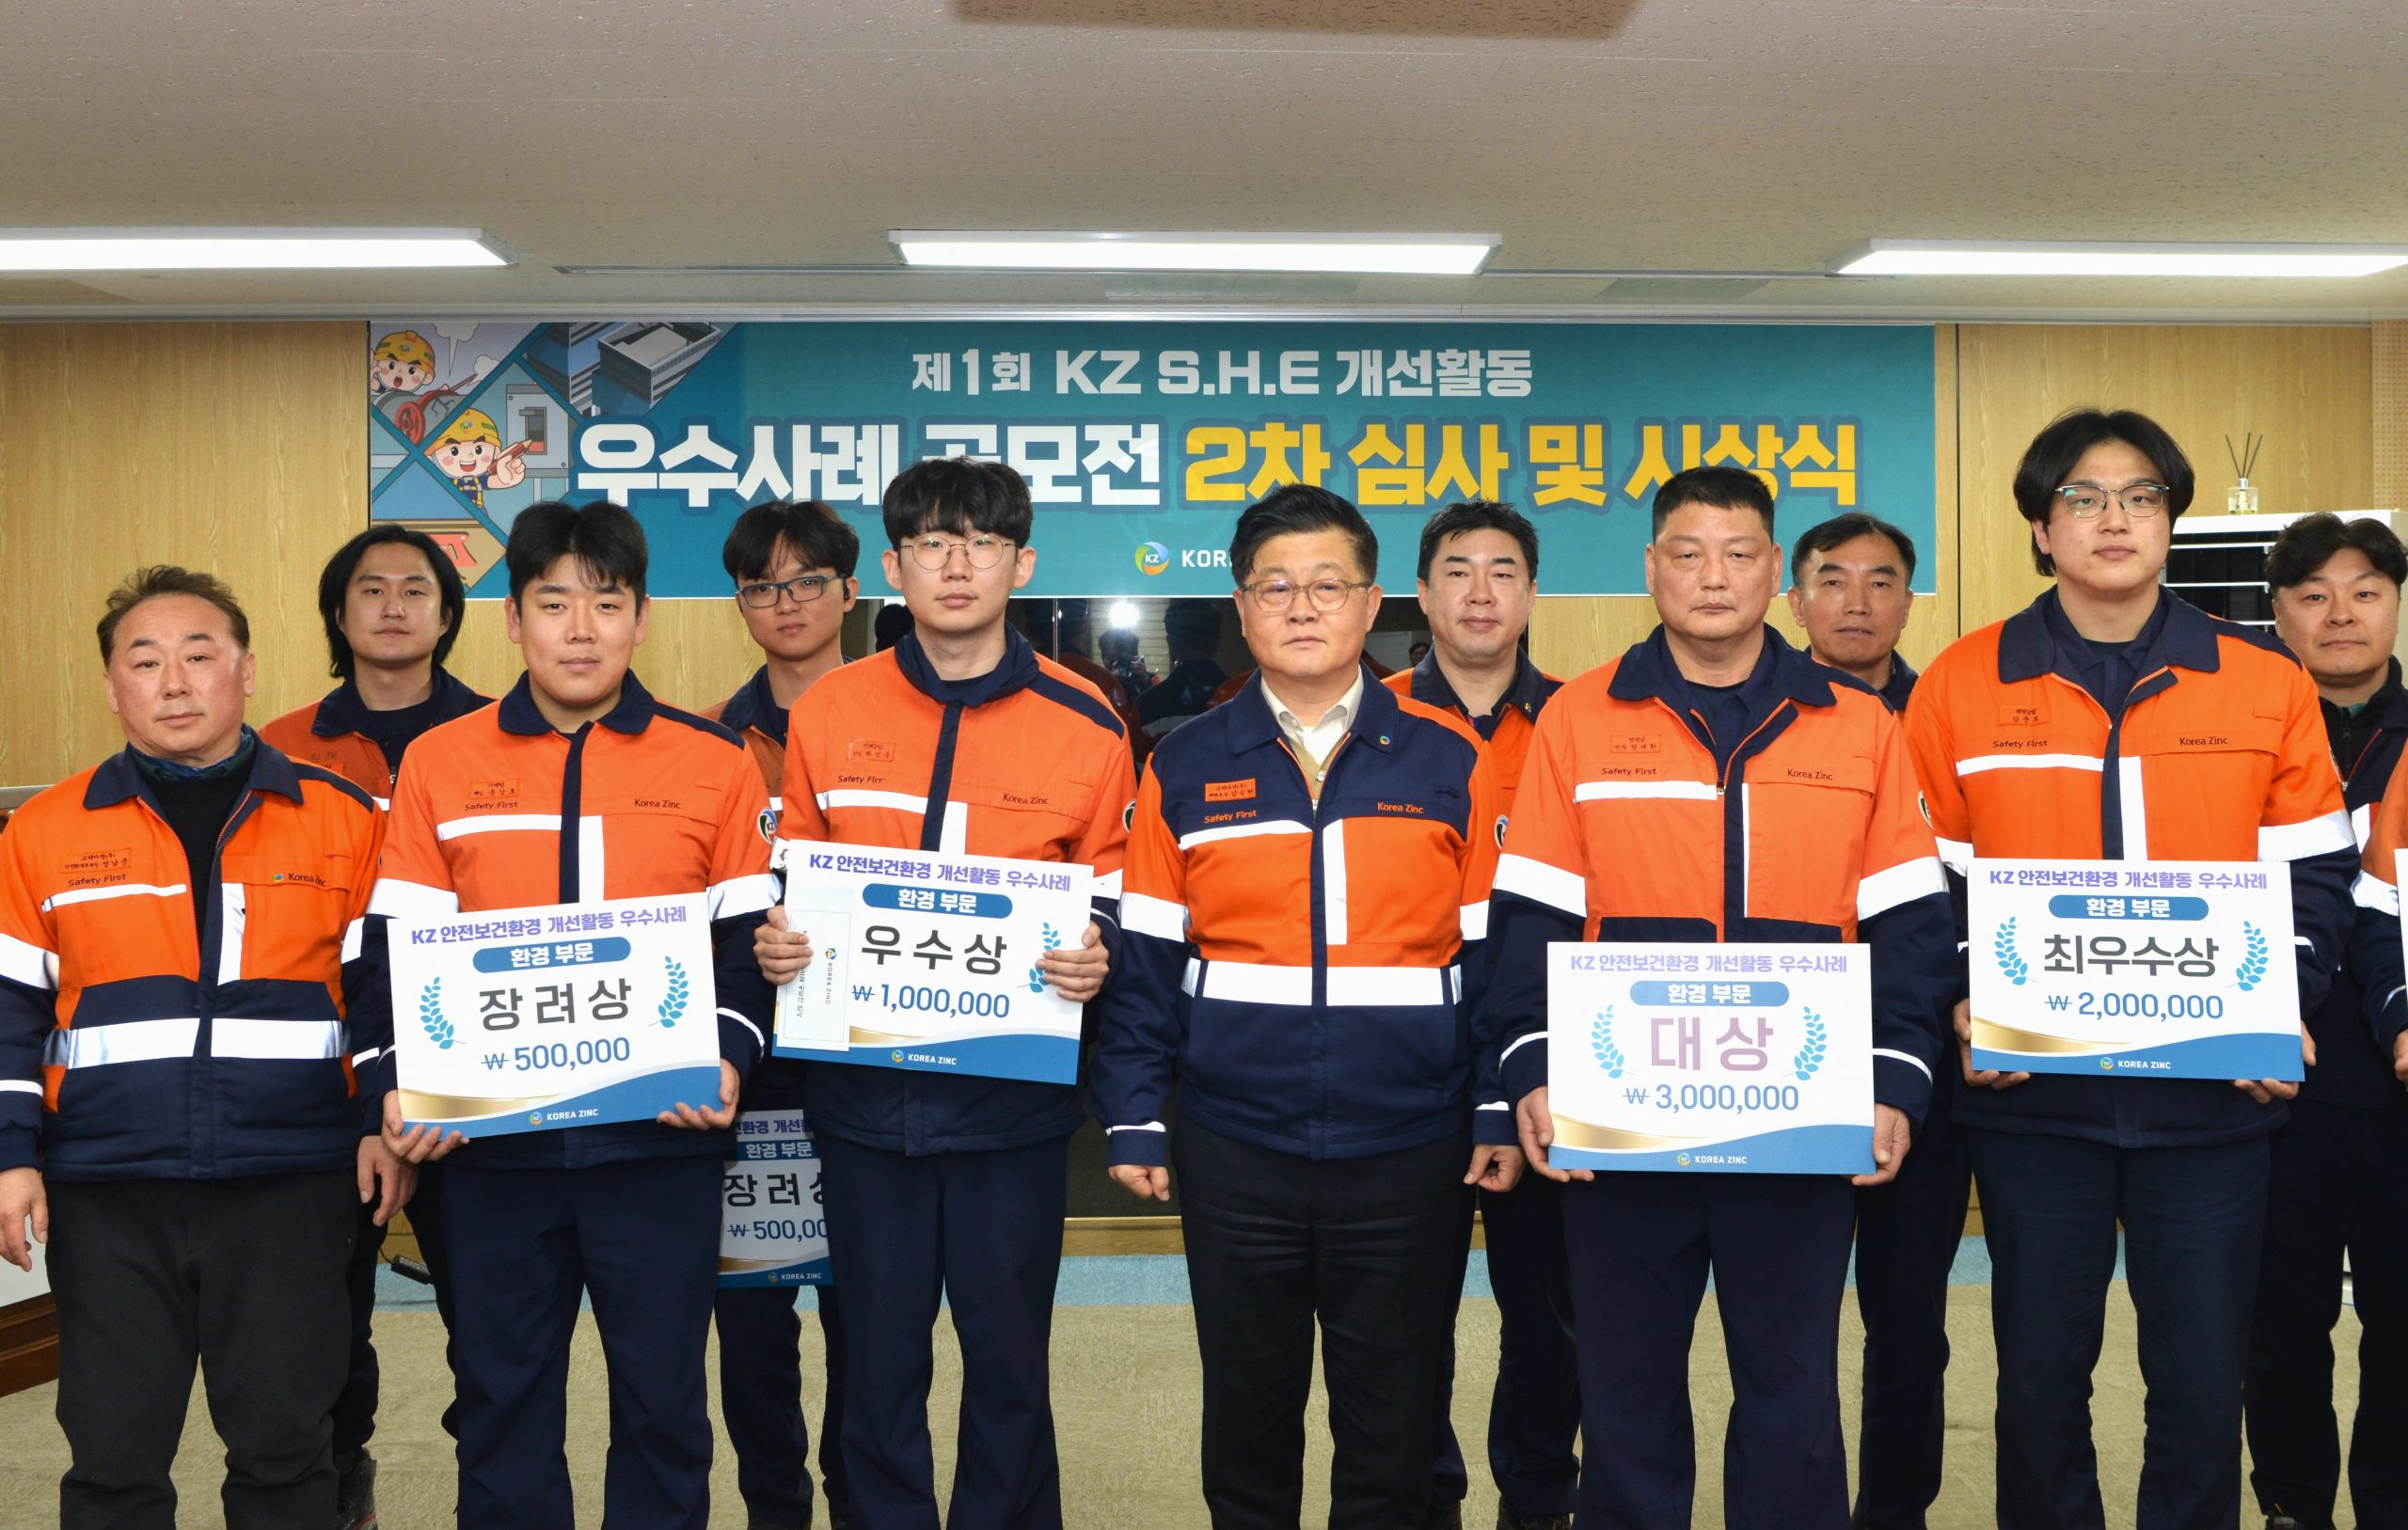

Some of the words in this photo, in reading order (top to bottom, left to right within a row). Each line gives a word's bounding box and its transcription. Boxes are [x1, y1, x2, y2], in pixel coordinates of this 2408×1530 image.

[912, 349, 1031, 396] 제1회
[1055, 351, 1141, 395] KZ
[1158, 350, 1322, 395] S.H.E
[1336, 349, 1533, 397] 개선활동
[578, 424, 899, 506] 우수사례
[1185, 422, 1330, 503] 2차
[1347, 422, 1510, 505] 심사
[1529, 424, 1608, 506] 및
[1145, 554, 1160, 563] KZ
[1181, 549, 1232, 568] KOR
[1992, 740, 2023, 749] Safety
[2026, 739, 2048, 748] First
[2179, 735, 2207, 746] Korea
[2209, 735, 2228, 745] Zinc
[1602, 767, 1632, 776] Safety
[1787, 768, 1812, 780] Korea
[1814, 770, 1833, 781] Zinc
[837, 775, 864, 784] Safety
[465, 802, 494, 811] Safety
[634, 798, 659, 809] Korea
[662, 799, 682, 809] Zinc
[1003, 793, 1028, 805] Korea
[1030, 796, 1049, 805] Zinc
[1377, 801, 1403, 812] Korea
[1404, 803, 1424, 814] Zinc
[1204, 812, 1234, 824] Safety
[1236, 809, 1257, 819] First
[69, 877, 101, 887] Safety
[103, 874, 126, 882] First
[288, 873, 314, 882] Korea
[809, 854, 833, 871] KZ
[836, 856, 931, 879] 안전보건환경
[937, 864, 1001, 886] 개선활동
[1006, 870, 1071, 892] 우수사례
[1990, 870, 2014, 885] KZ
[2018, 870, 2118, 888] 안전보건환경
[2125, 870, 2193, 889] 개선활동
[2198, 872, 2267, 891] 우수사례
[897, 888, 936, 911] 환경
[940, 891, 977, 914] 부문
[2086, 897, 2127, 917] 환경
[2131, 898, 2171, 918] 부문
[411, 930, 436, 945] KZ
[440, 917, 542, 944] 안전보건환경
[547, 912, 613, 934] 개선활동
[620, 906, 687, 929] 우수사례
[511, 947, 551, 968] 환경
[555, 943, 594, 965] 부문
[861, 924, 1007, 976] 우수상
[2043, 934, 2220, 978] 최우수상
[1571, 956, 1595, 970] KZ
[1598, 954, 1700, 973] 안전보건환경
[1705, 954, 1773, 973] 개선활동
[1779, 955, 1847, 973] 우수사례
[1668, 985, 1707, 1004] 환경
[1712, 985, 1751, 1004] 부문
[479, 977, 632, 1033] 장려상
[1651, 1016, 1774, 1073] 대상
[908, 1053, 936, 1064] KOREA
[937, 1055, 957, 1065] ZINC
[2118, 1060, 2148, 1070] KOREA
[2150, 1060, 2171, 1070] ZINC
[547, 1110, 577, 1121] KOREA
[578, 1108, 598, 1118] ZINC
[746, 1143, 777, 1159] 환경
[782, 1142, 812, 1158] 부문
[1695, 1155, 1725, 1164] KOREA
[1728, 1155, 1748, 1165] ZINC
